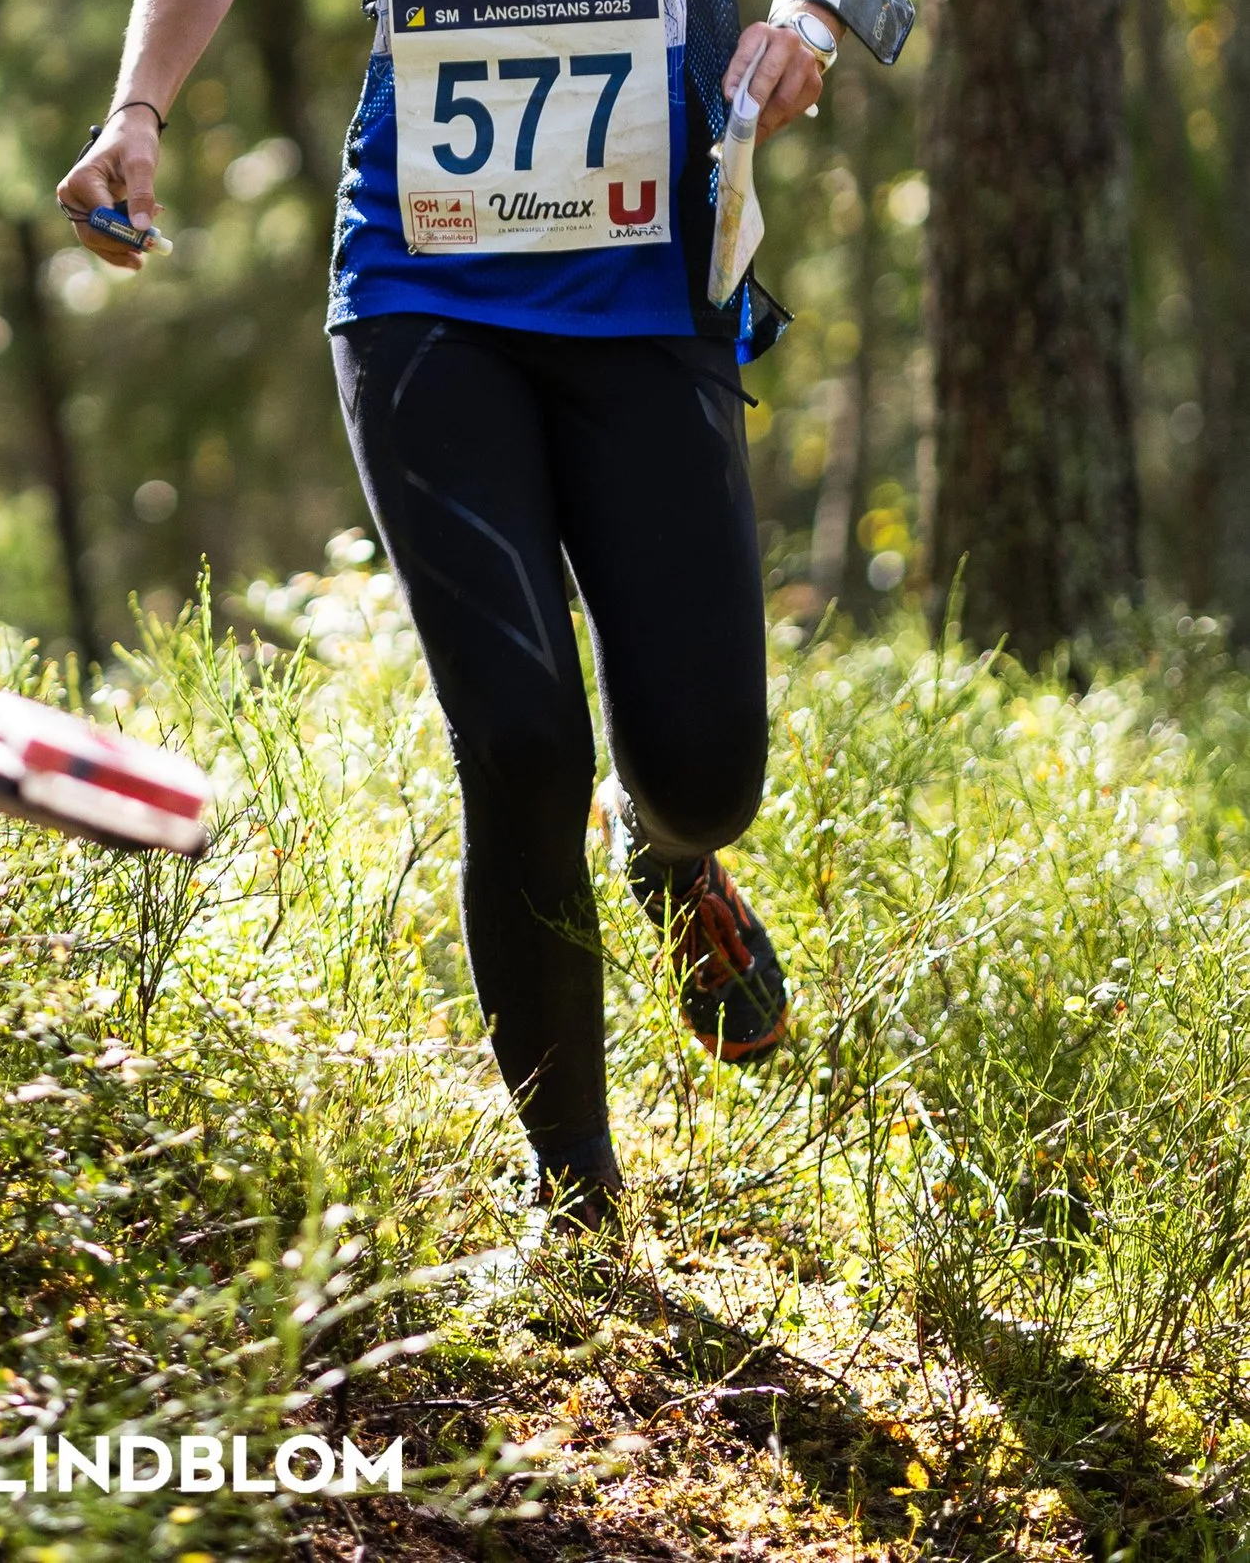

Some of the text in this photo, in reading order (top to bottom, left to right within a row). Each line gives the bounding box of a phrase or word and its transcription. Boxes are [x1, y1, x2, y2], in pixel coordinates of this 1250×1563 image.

[435, 0, 631, 23] SM LÅNGDISTANS 2025
[432, 52, 632, 175] 577
[489, 192, 594, 221] Ullmax
[415, 214, 473, 229] Tisaren
